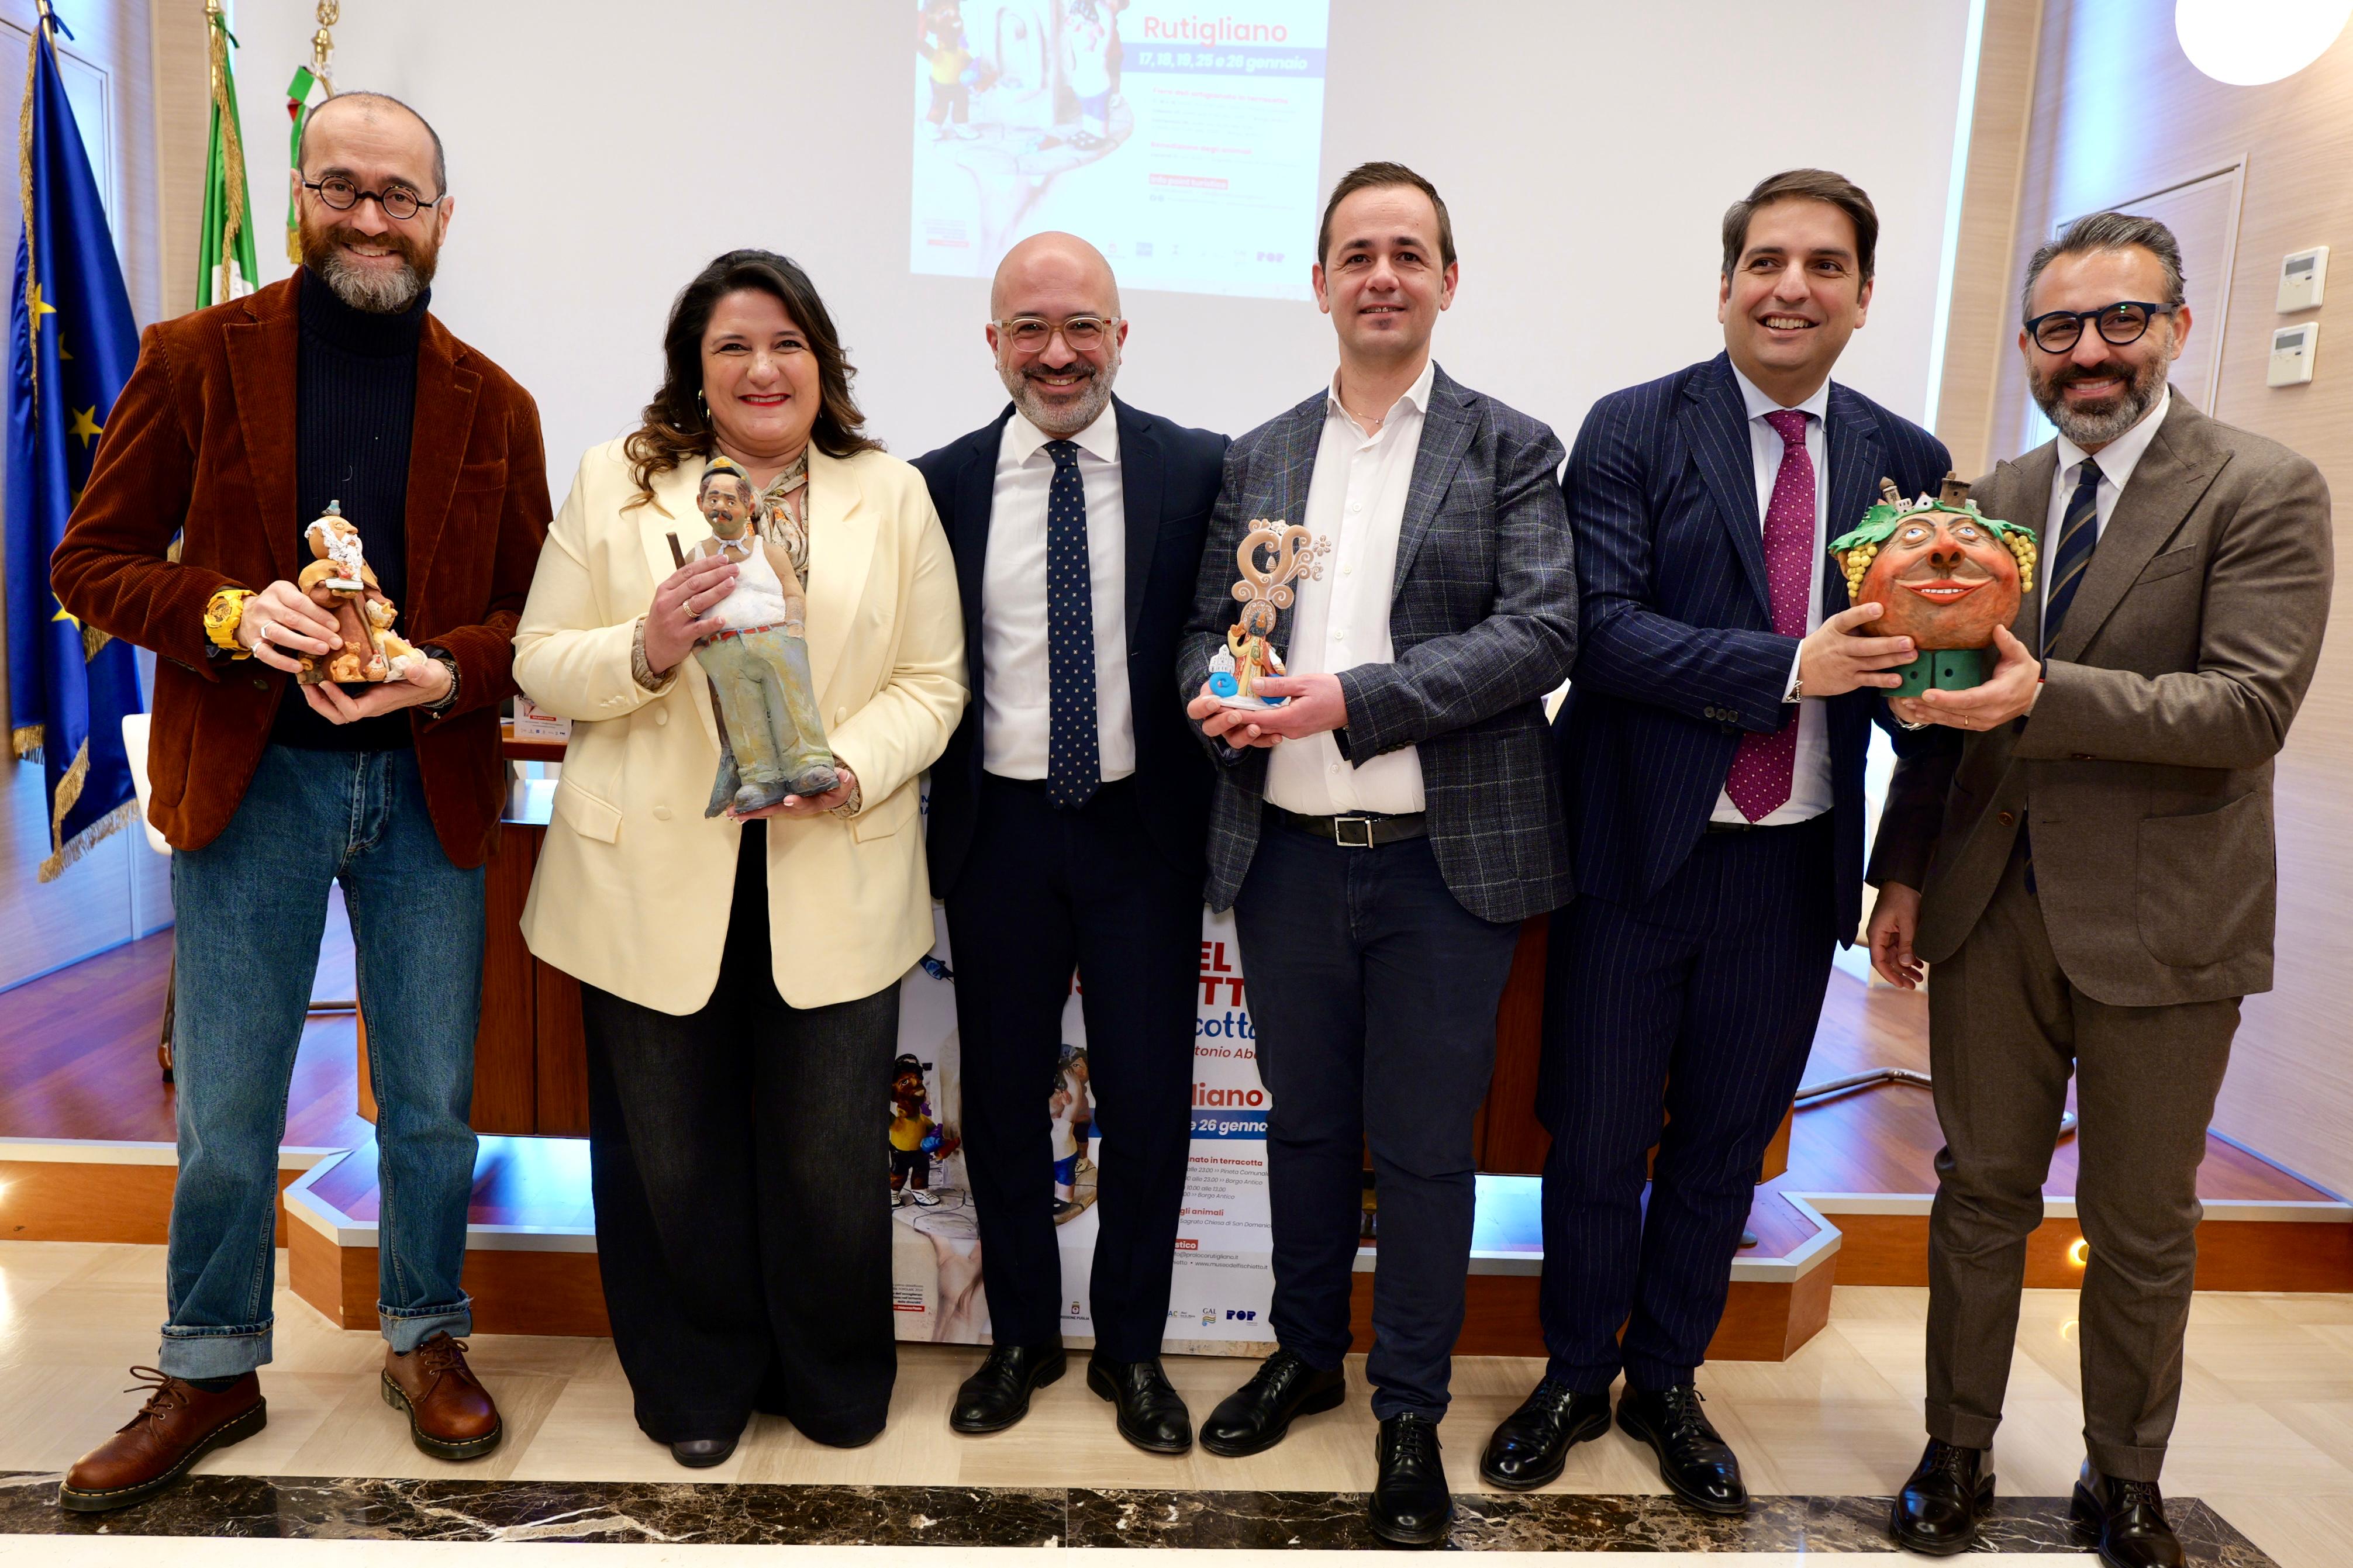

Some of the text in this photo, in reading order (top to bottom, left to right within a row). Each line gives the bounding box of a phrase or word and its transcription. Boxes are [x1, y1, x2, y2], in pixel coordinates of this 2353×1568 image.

[1144, 15, 1288, 49] Rutigliano
[1245, 56, 1307, 72] gennaio
[1195, 1045, 1231, 1058] tonio
[1192, 1082, 1263, 1106] liano
[1191, 1121, 1196, 1131] e
[1199, 1119, 1217, 1131] 26
[1220, 1158, 1262, 1166] terracotta
[1180, 1208, 1191, 1216] gli
[1195, 1261, 1268, 1270] www.museodelfischietto.it
[1226, 1310, 1256, 1321] POP
